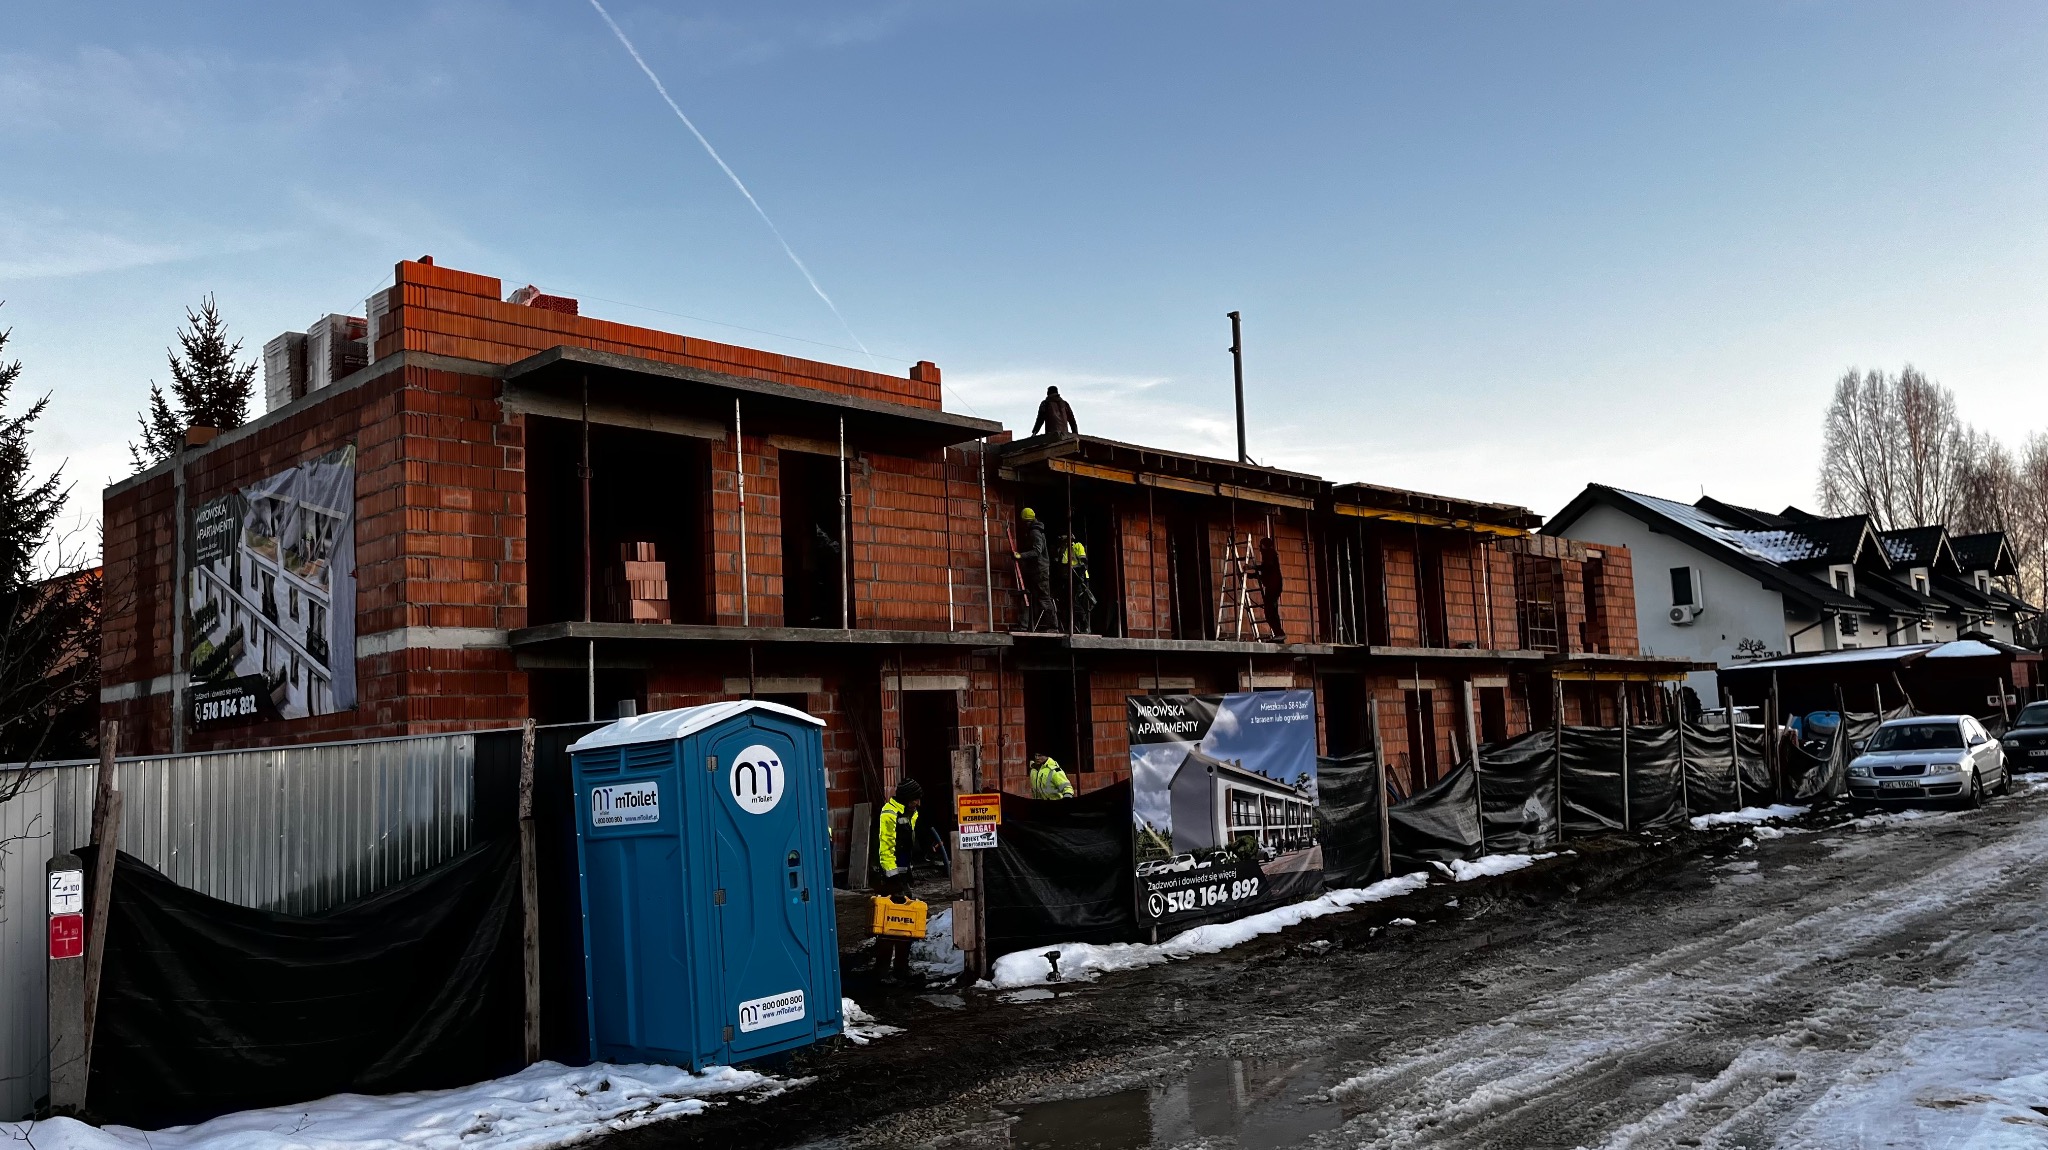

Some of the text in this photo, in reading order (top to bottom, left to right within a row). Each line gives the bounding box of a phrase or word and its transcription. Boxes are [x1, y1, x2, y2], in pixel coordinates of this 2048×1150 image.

[202, 694, 257, 720] 518 164 892
[1137, 704, 1185, 717] MIROWSKA
[1137, 720, 1199, 735] APARTAMENTY
[615, 790, 657, 809] mToilet
[964, 824, 992, 834] UWAGA!
[52, 877, 61, 889] Z
[1147, 868, 1237, 891] Zadzwoń i dowiedz się więcej
[1167, 877, 1259, 913] 518 164 892
[52, 921, 62, 934] H
[887, 916, 914, 924] NIVEL
[762, 994, 803, 1011] 800 000 800
